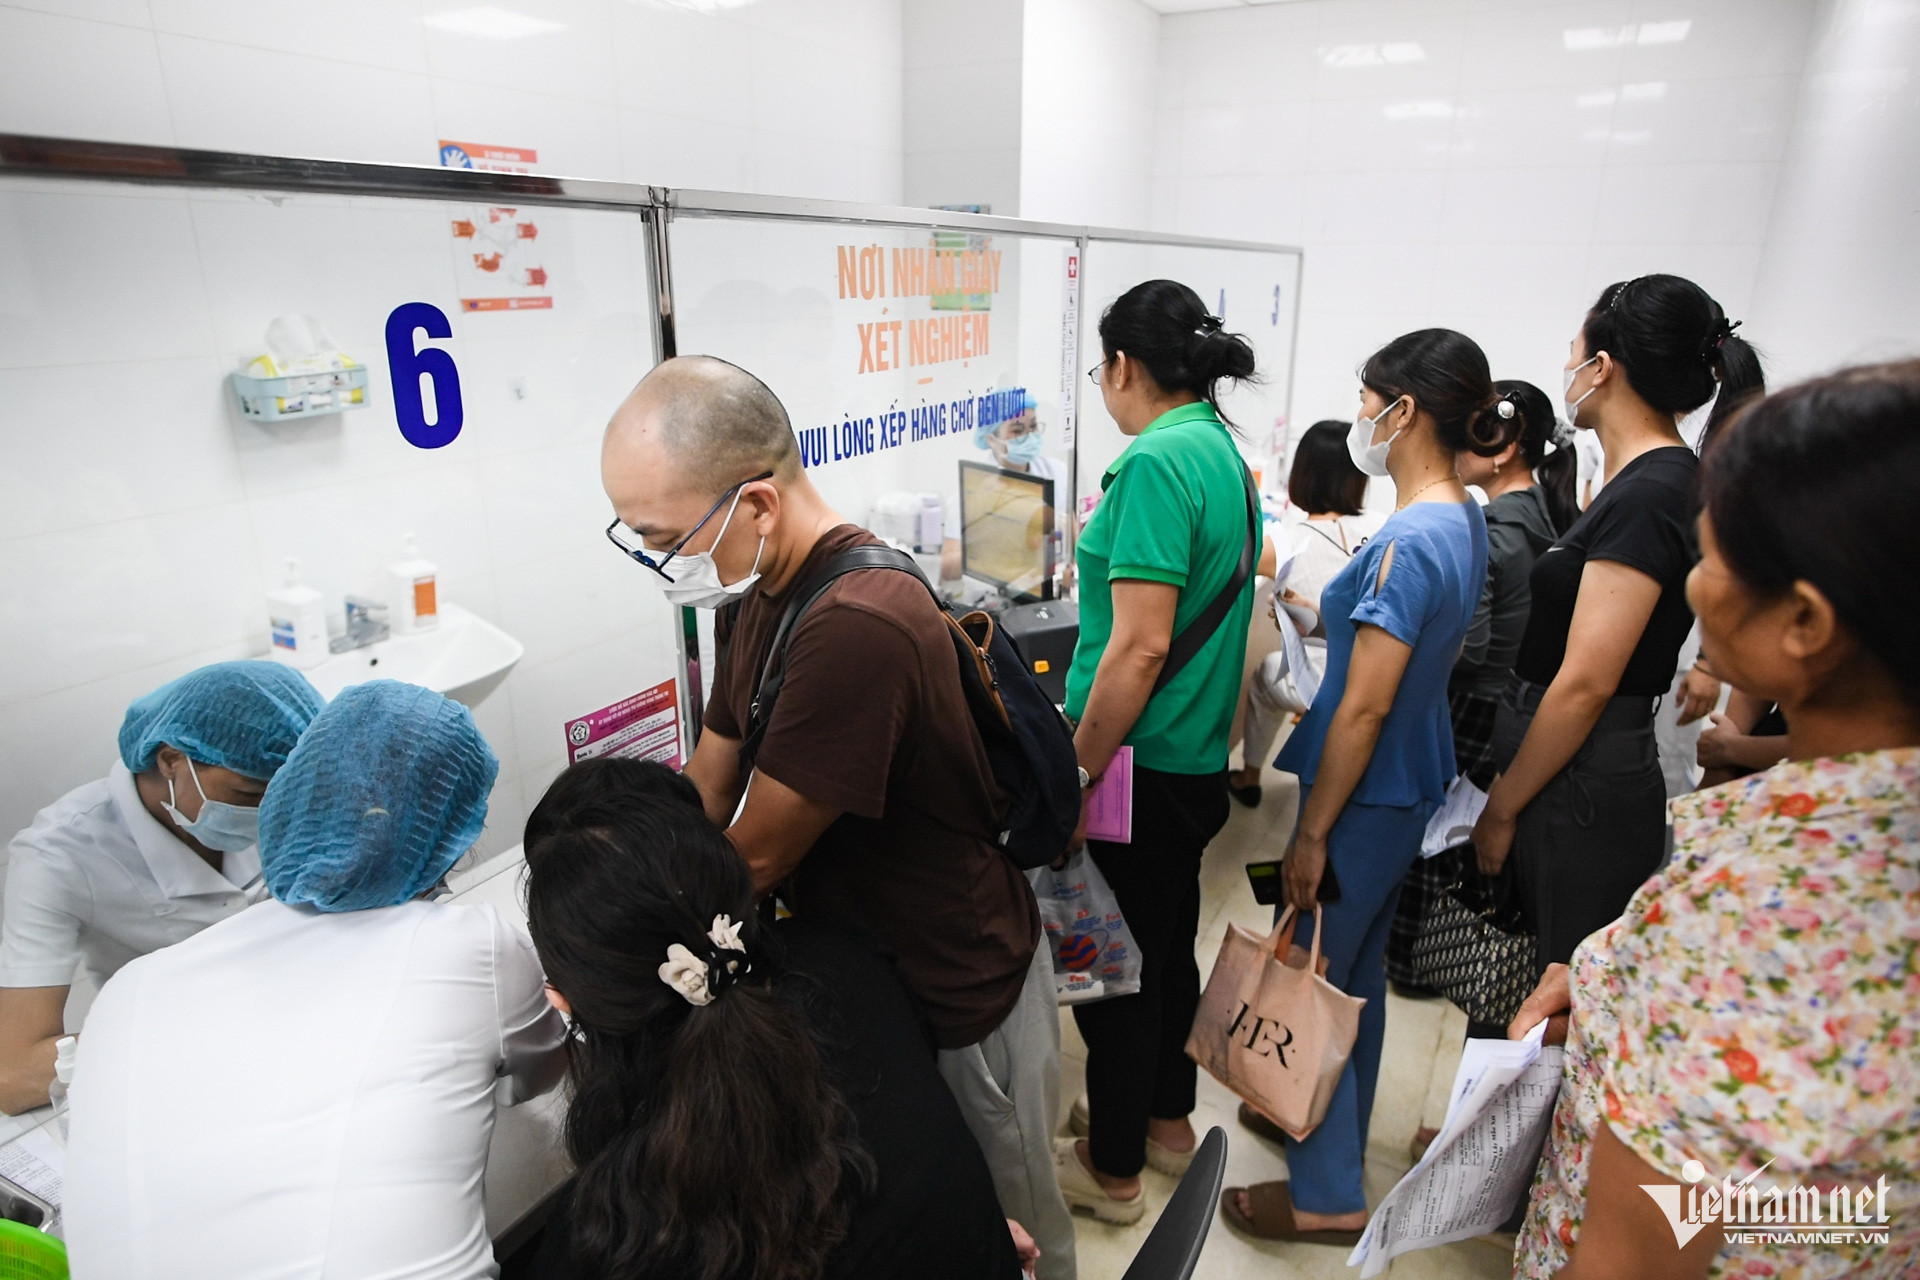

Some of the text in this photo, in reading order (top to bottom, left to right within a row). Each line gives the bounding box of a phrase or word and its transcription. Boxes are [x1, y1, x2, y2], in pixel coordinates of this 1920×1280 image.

[837, 236, 1002, 307] NƠI NHẬN GIẤY
[857, 307, 902, 375] XÉT
[908, 304, 990, 368] NGHIỆM
[385, 301, 464, 450] 6
[799, 386, 1026, 469] VUI LÒNG XẾP HÀNG CHỜ ĐẾN LƯỢT
[1227, 1000, 1293, 1069] HER
